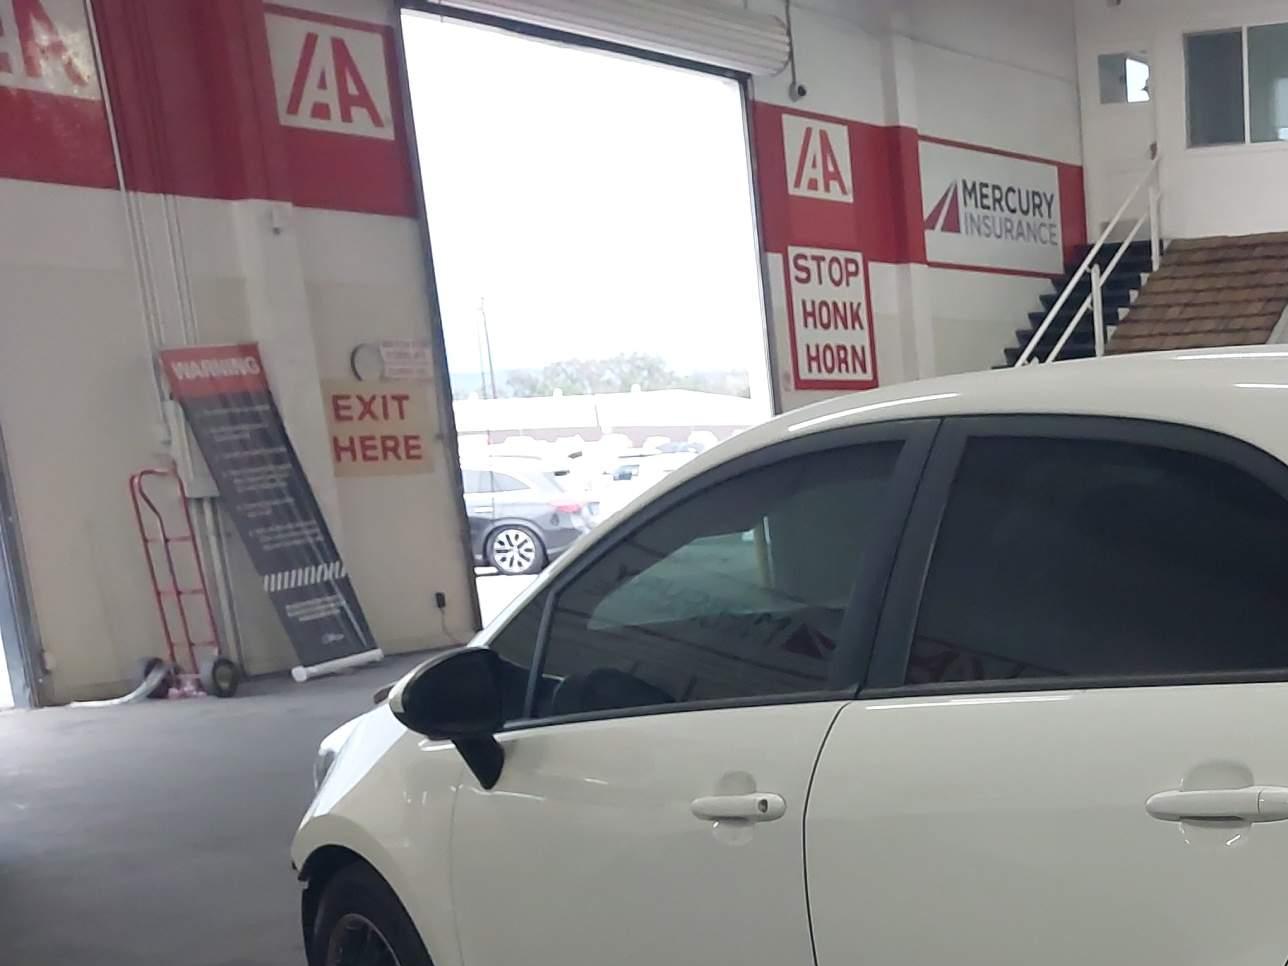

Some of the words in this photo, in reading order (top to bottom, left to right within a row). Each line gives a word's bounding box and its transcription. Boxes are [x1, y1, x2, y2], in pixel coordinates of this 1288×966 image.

[962, 179, 1054, 219] MERCURY
[964, 214, 1059, 246] INSURANCE
[792, 253, 860, 288] STOP
[801, 298, 864, 331] HONK
[171, 356, 261, 380] WARNING
[805, 343, 867, 375] HORN
[331, 394, 411, 422] EXIT
[332, 435, 424, 463] HERE
